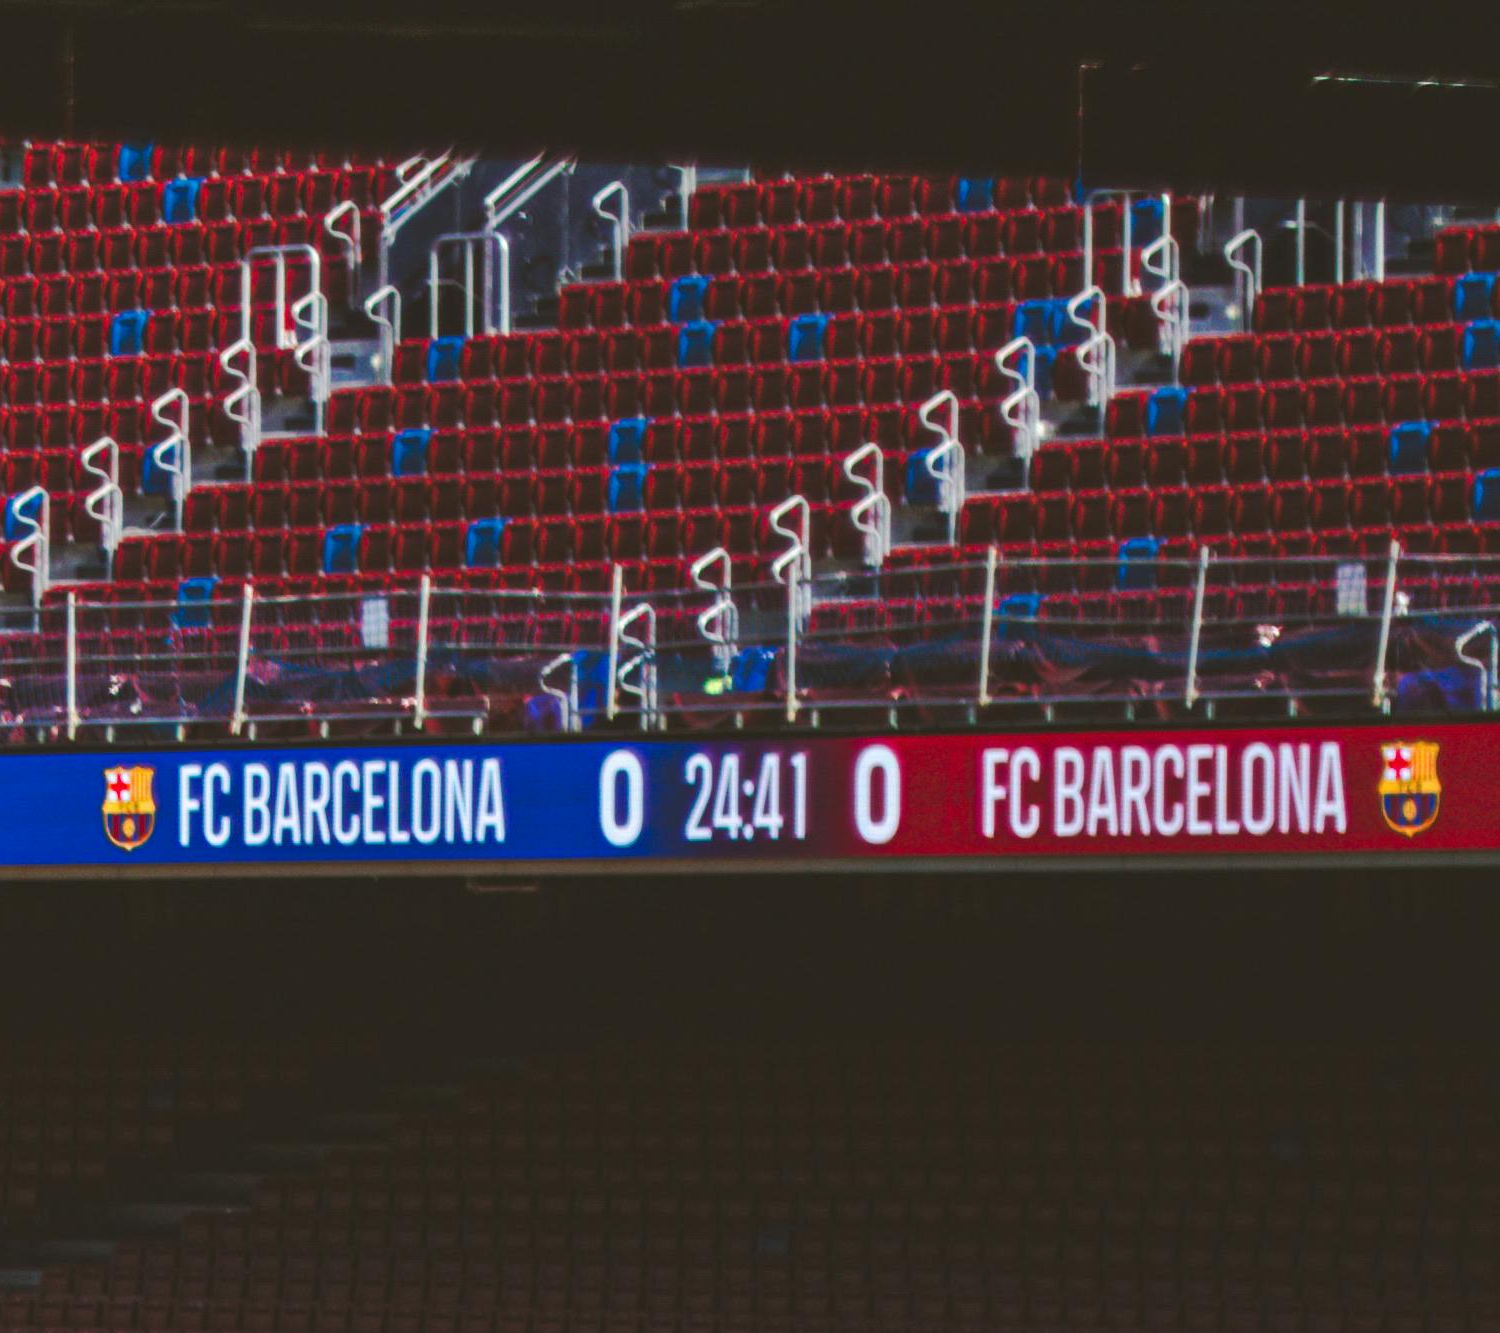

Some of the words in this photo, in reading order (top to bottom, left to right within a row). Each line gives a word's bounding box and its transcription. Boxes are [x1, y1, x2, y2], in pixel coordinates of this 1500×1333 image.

[178, 763, 231, 848] FC
[243, 758, 505, 846] BARCELONA
[600, 749, 644, 846] 0
[685, 752, 808, 839] 24:41
[854, 744, 901, 844] 0
[982, 747, 1042, 838] FC
[1054, 741, 1347, 837] BARCELONA
